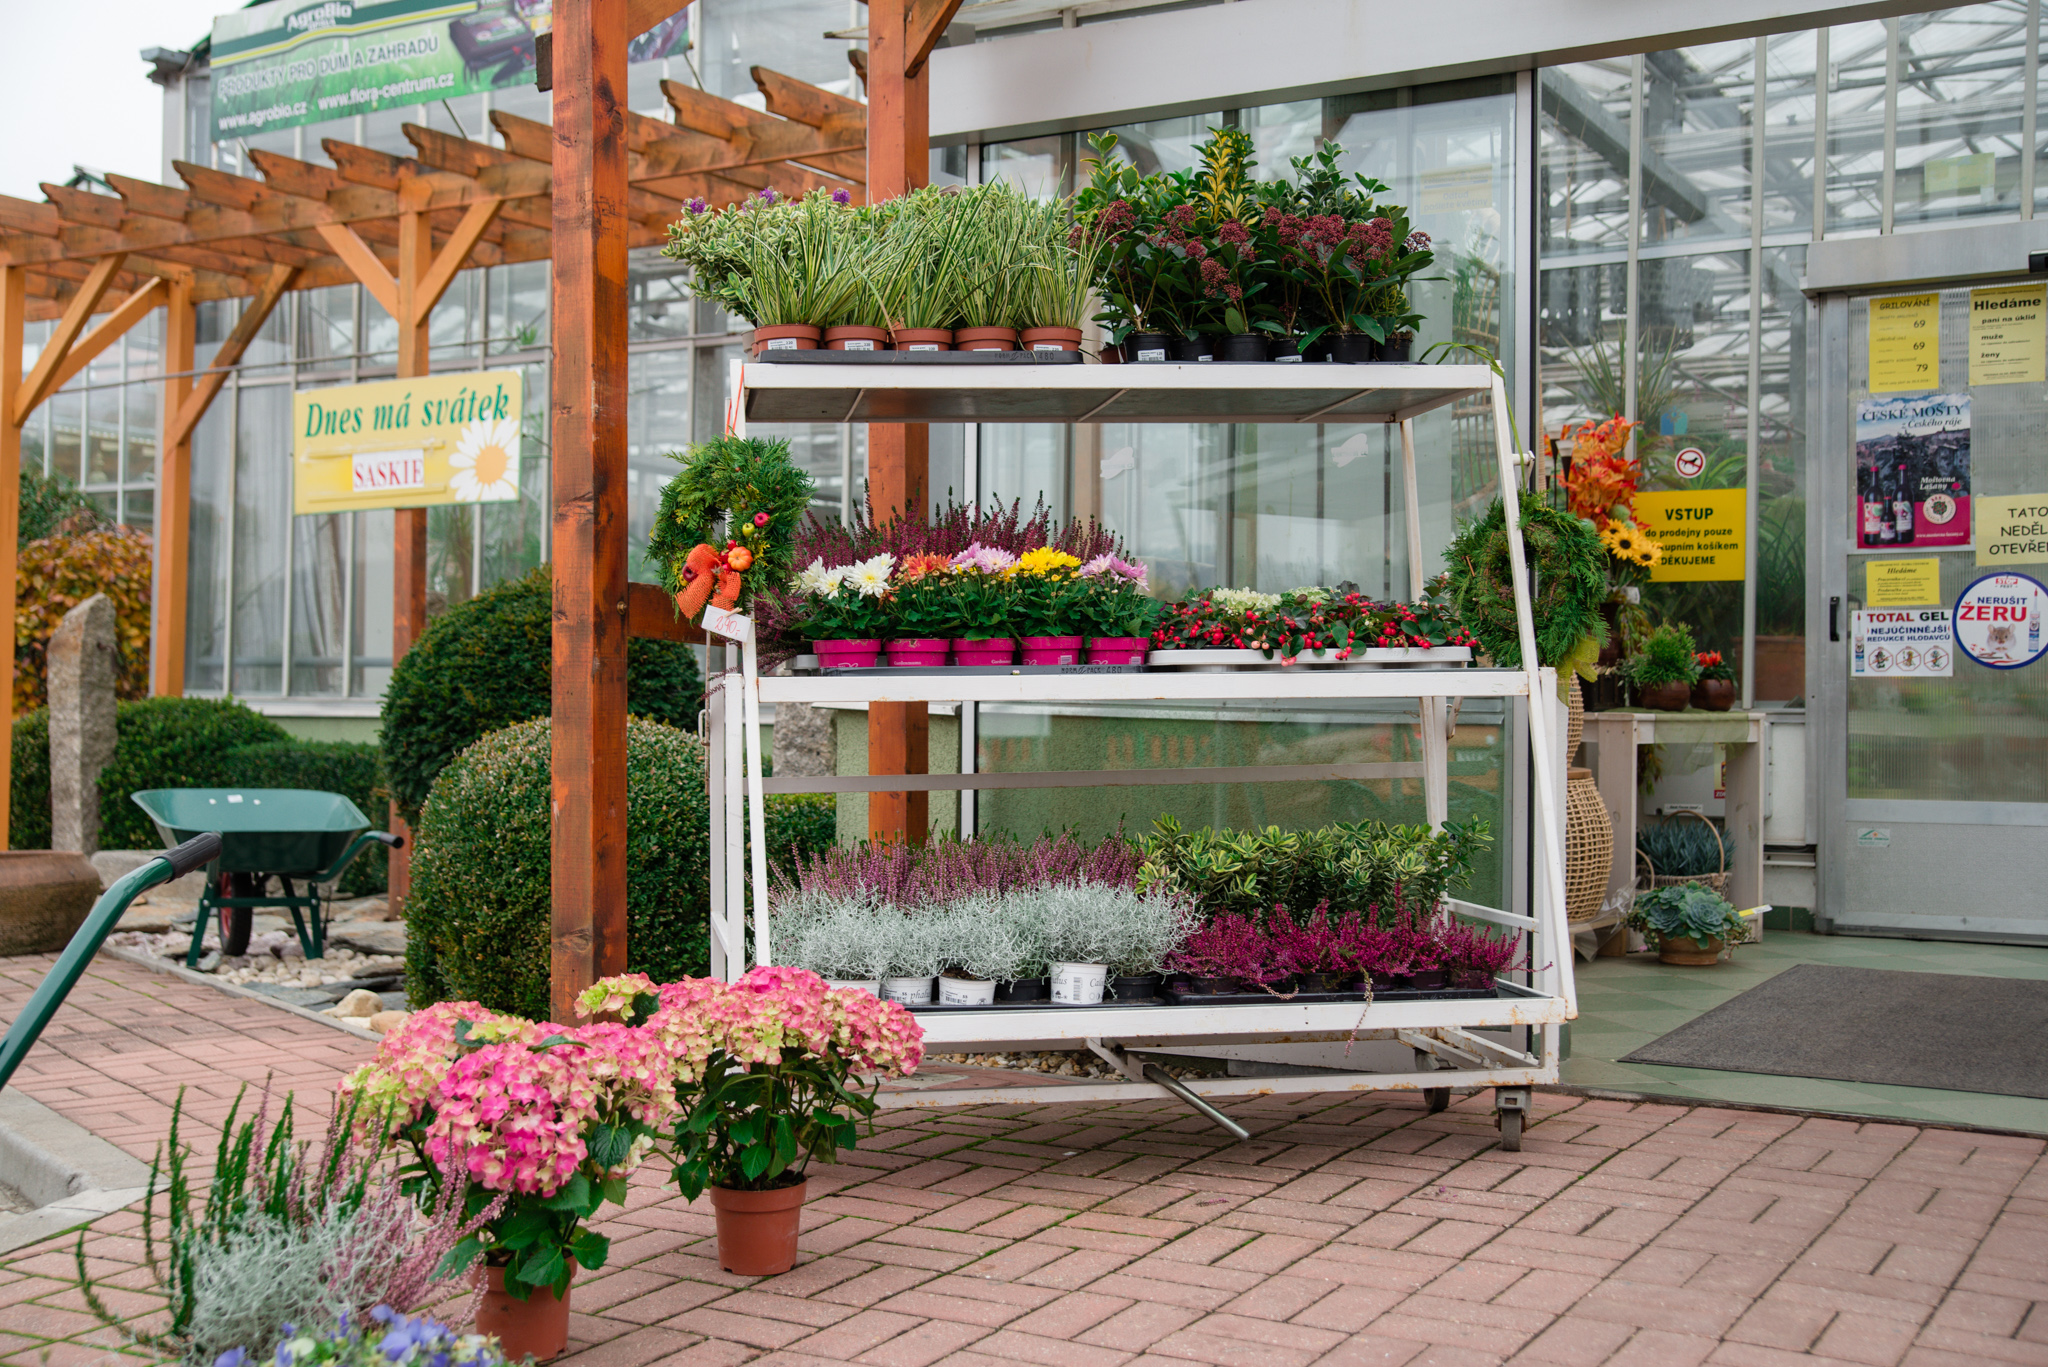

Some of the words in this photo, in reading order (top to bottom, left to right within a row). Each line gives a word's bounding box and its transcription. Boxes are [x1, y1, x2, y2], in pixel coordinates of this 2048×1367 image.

[287, 1, 352, 33] AgroBio
[219, 67, 286, 97] PRODUKTY
[289, 57, 316, 81] PRO
[353, 50, 363, 67] A
[368, 36, 439, 64] ZAHRADU
[218, 103, 307, 130] www.agrobio.cz
[318, 72, 455, 110] www.flora-centrum.cz
[1880, 297, 1931, 310] GRILOVÁNÍ
[1974, 297, 2041, 311] Hledáme
[1913, 320, 1926, 328] 69
[1913, 341, 1925, 350] 69
[1039, 352, 1055, 360] 480
[1916, 363, 1928, 372] 79
[305, 403, 363, 437] Dnes
[374, 392, 412, 430] má
[422, 383, 509, 427] svátek
[1862, 406, 1908, 422] ČESKÉ
[1912, 403, 1963, 418] MOŠTY
[1908, 418, 1943, 428] Českého
[1945, 419, 1962, 427] ráje
[354, 459, 424, 488] SASKIE
[1665, 508, 1714, 520] VSTUP
[2008, 506, 2048, 518] TATO
[1645, 528, 1656, 537] do
[1659, 528, 1701, 539] prodejny
[1704, 528, 1733, 537] pouze
[1697, 541, 1738, 550] košíkem
[1989, 539, 2048, 555] OTEVŘE
[1661, 554, 1716, 565] DĚKUJEME
[1977, 596, 2027, 605] NERUŠIT
[1867, 612, 1914, 623] TOTAL
[1919, 611, 1949, 621] GEL
[1959, 601, 2027, 622] ŽERU
[1871, 625, 1947, 635] NEJÚČINNĚJŠÍ
